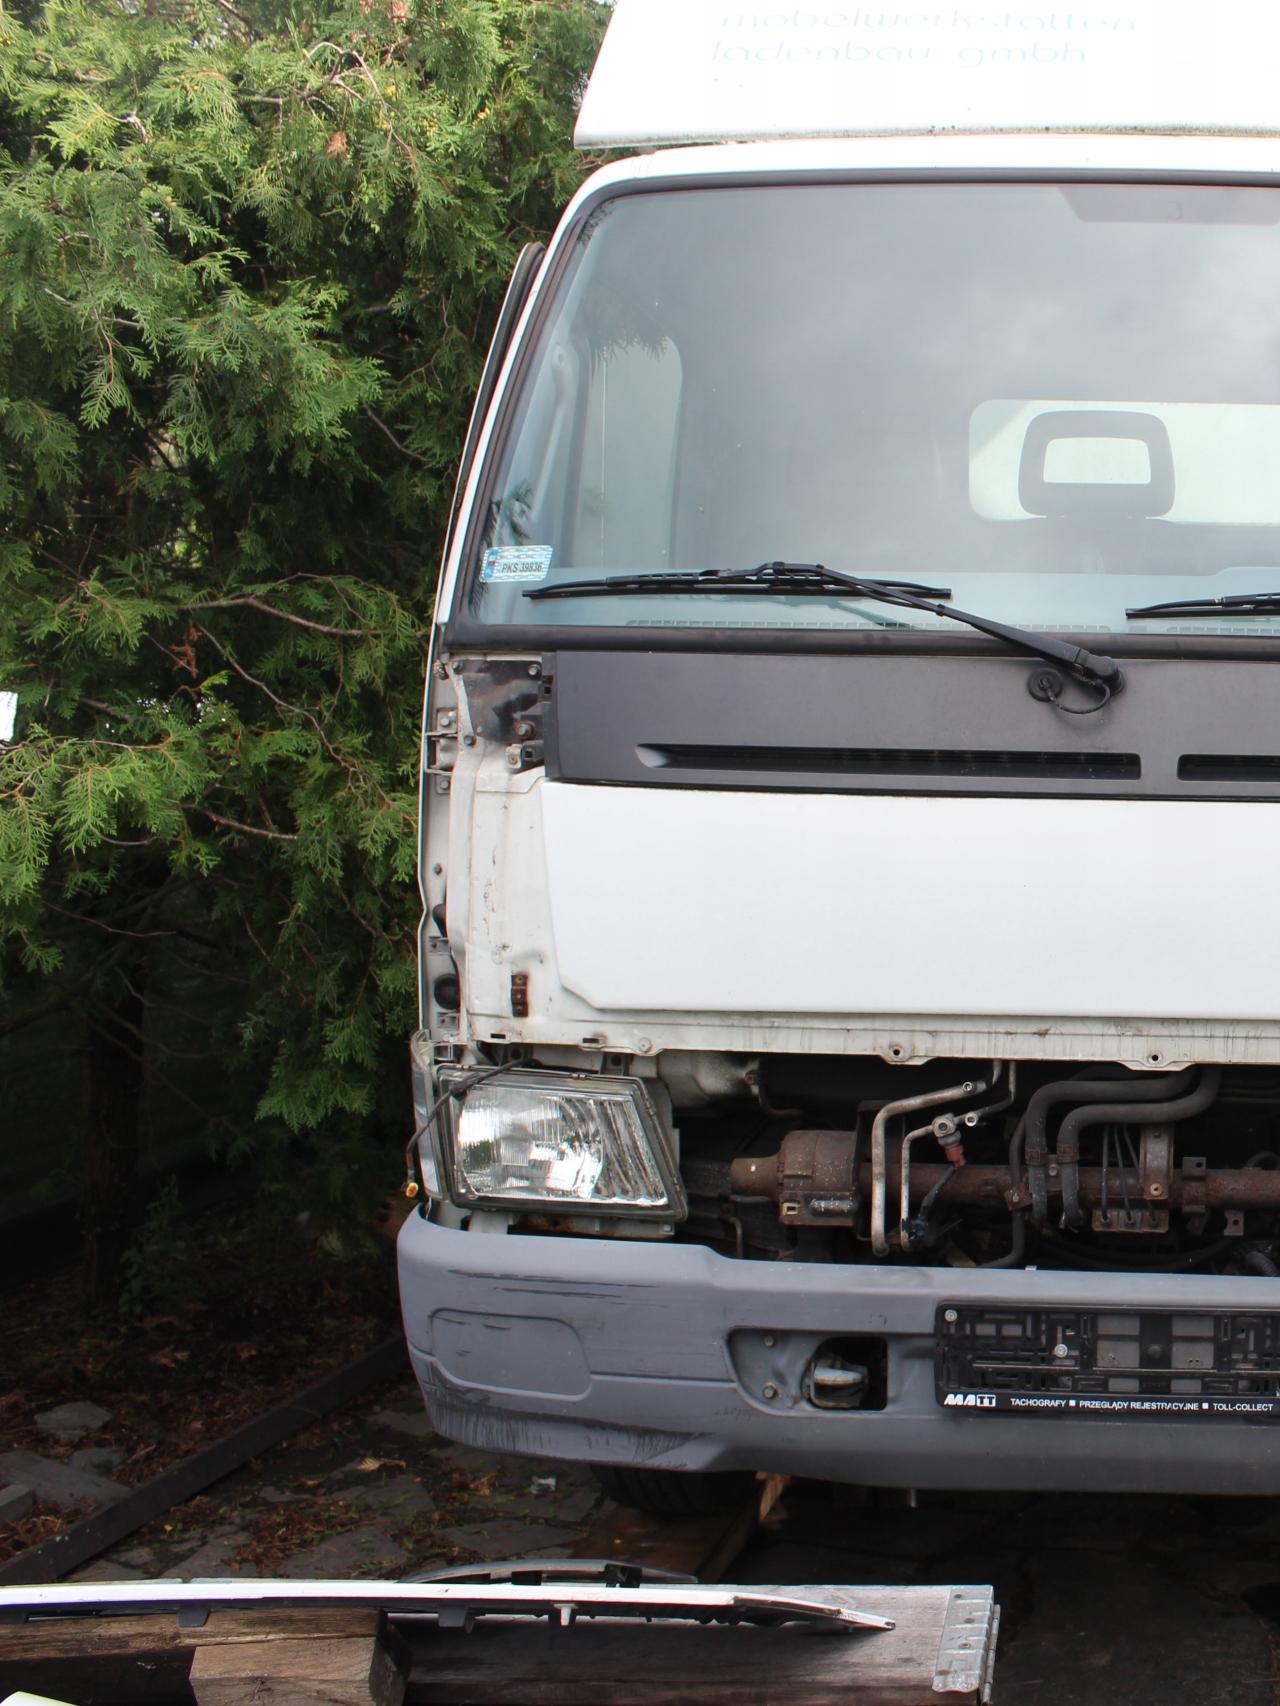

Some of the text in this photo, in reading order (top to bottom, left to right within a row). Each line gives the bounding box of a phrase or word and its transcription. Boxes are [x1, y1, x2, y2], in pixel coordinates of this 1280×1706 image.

[711, 38, 1088, 67] ladenbau gmbh
[1010, 1398, 1066, 1407] TACHOGRAFY
[1079, 1400, 1129, 1411] PRZEGLĄDY
[1130, 1401, 1199, 1411] REJESTRACYJNE
[1213, 1402, 1274, 1411] TOLL-COLLECT
